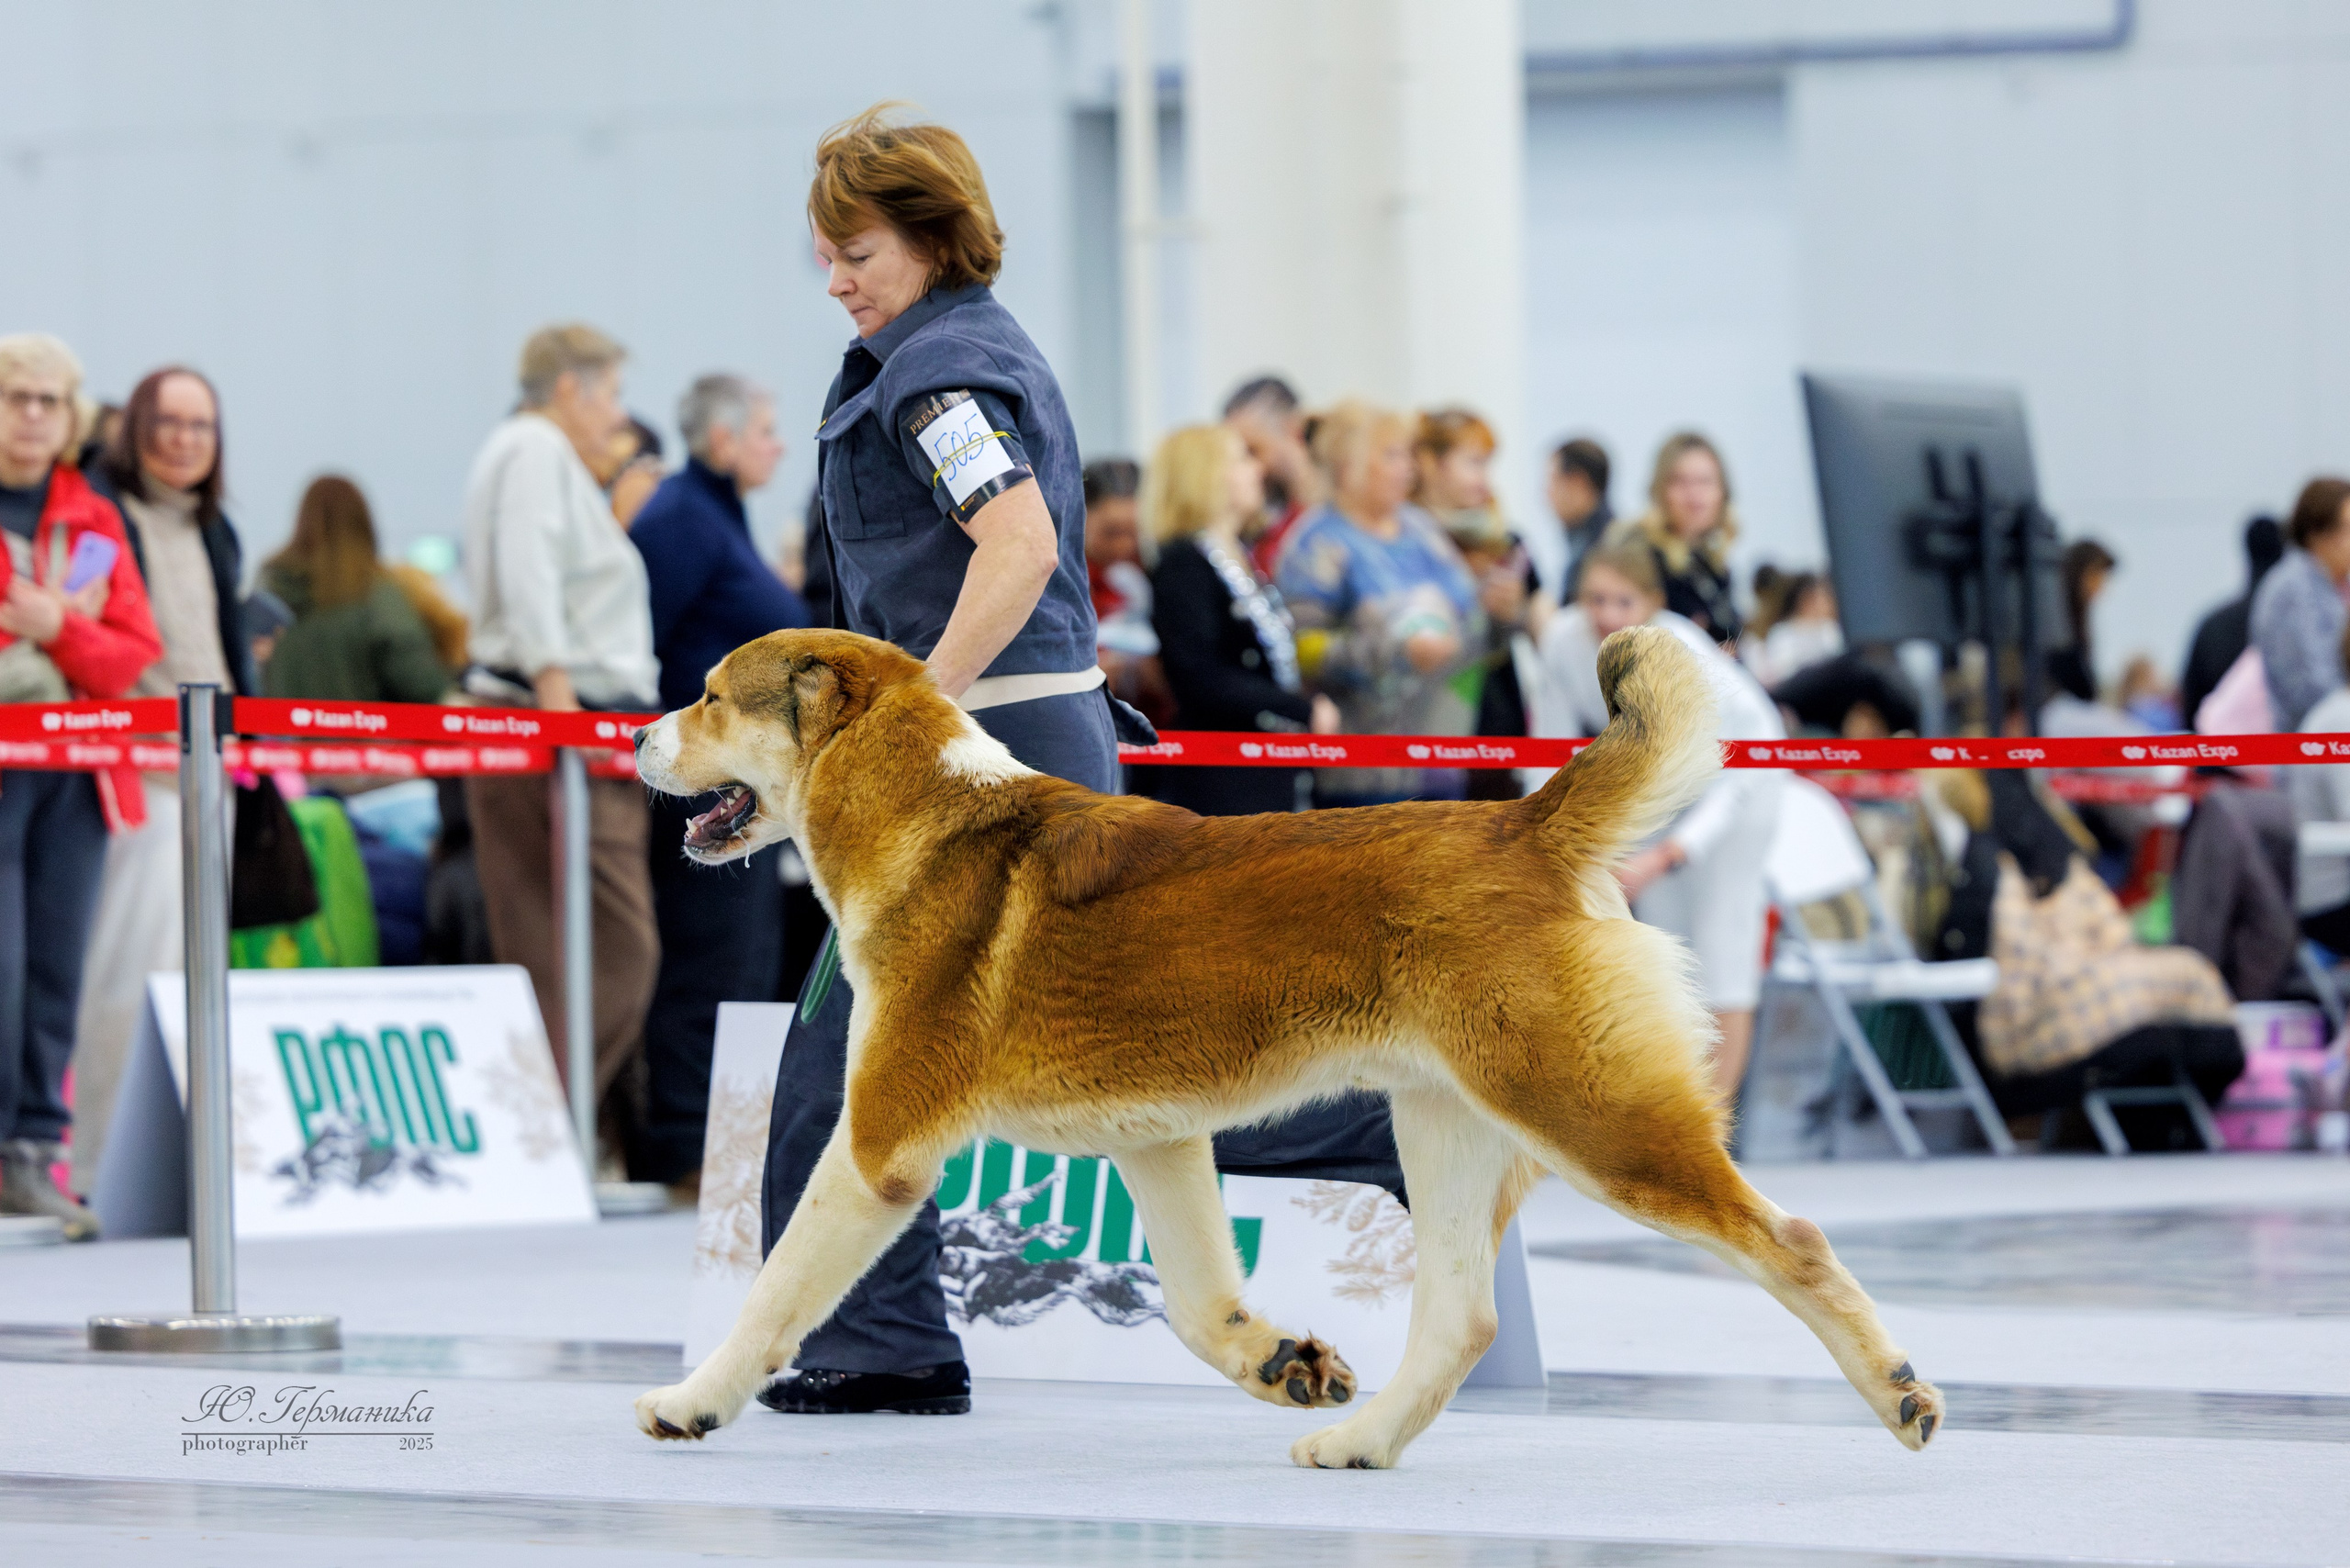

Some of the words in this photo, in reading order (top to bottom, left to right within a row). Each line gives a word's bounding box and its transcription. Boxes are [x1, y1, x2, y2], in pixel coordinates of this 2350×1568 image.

[910, 393, 959, 435] PREMIE
[934, 412, 984, 482] 505
[465, 715, 506, 734] Kazan
[506, 716, 541, 737] Expo
[1265, 743, 1311, 758] Kazan
[1309, 743, 1347, 761] Expo
[1433, 745, 1478, 759] Kazan
[1476, 744, 1516, 762] Expo
[1774, 747, 1823, 761] Kazan
[1820, 746, 1861, 763] Expo
[2149, 745, 2198, 759] Kazan
[2197, 744, 2238, 760] Expo
